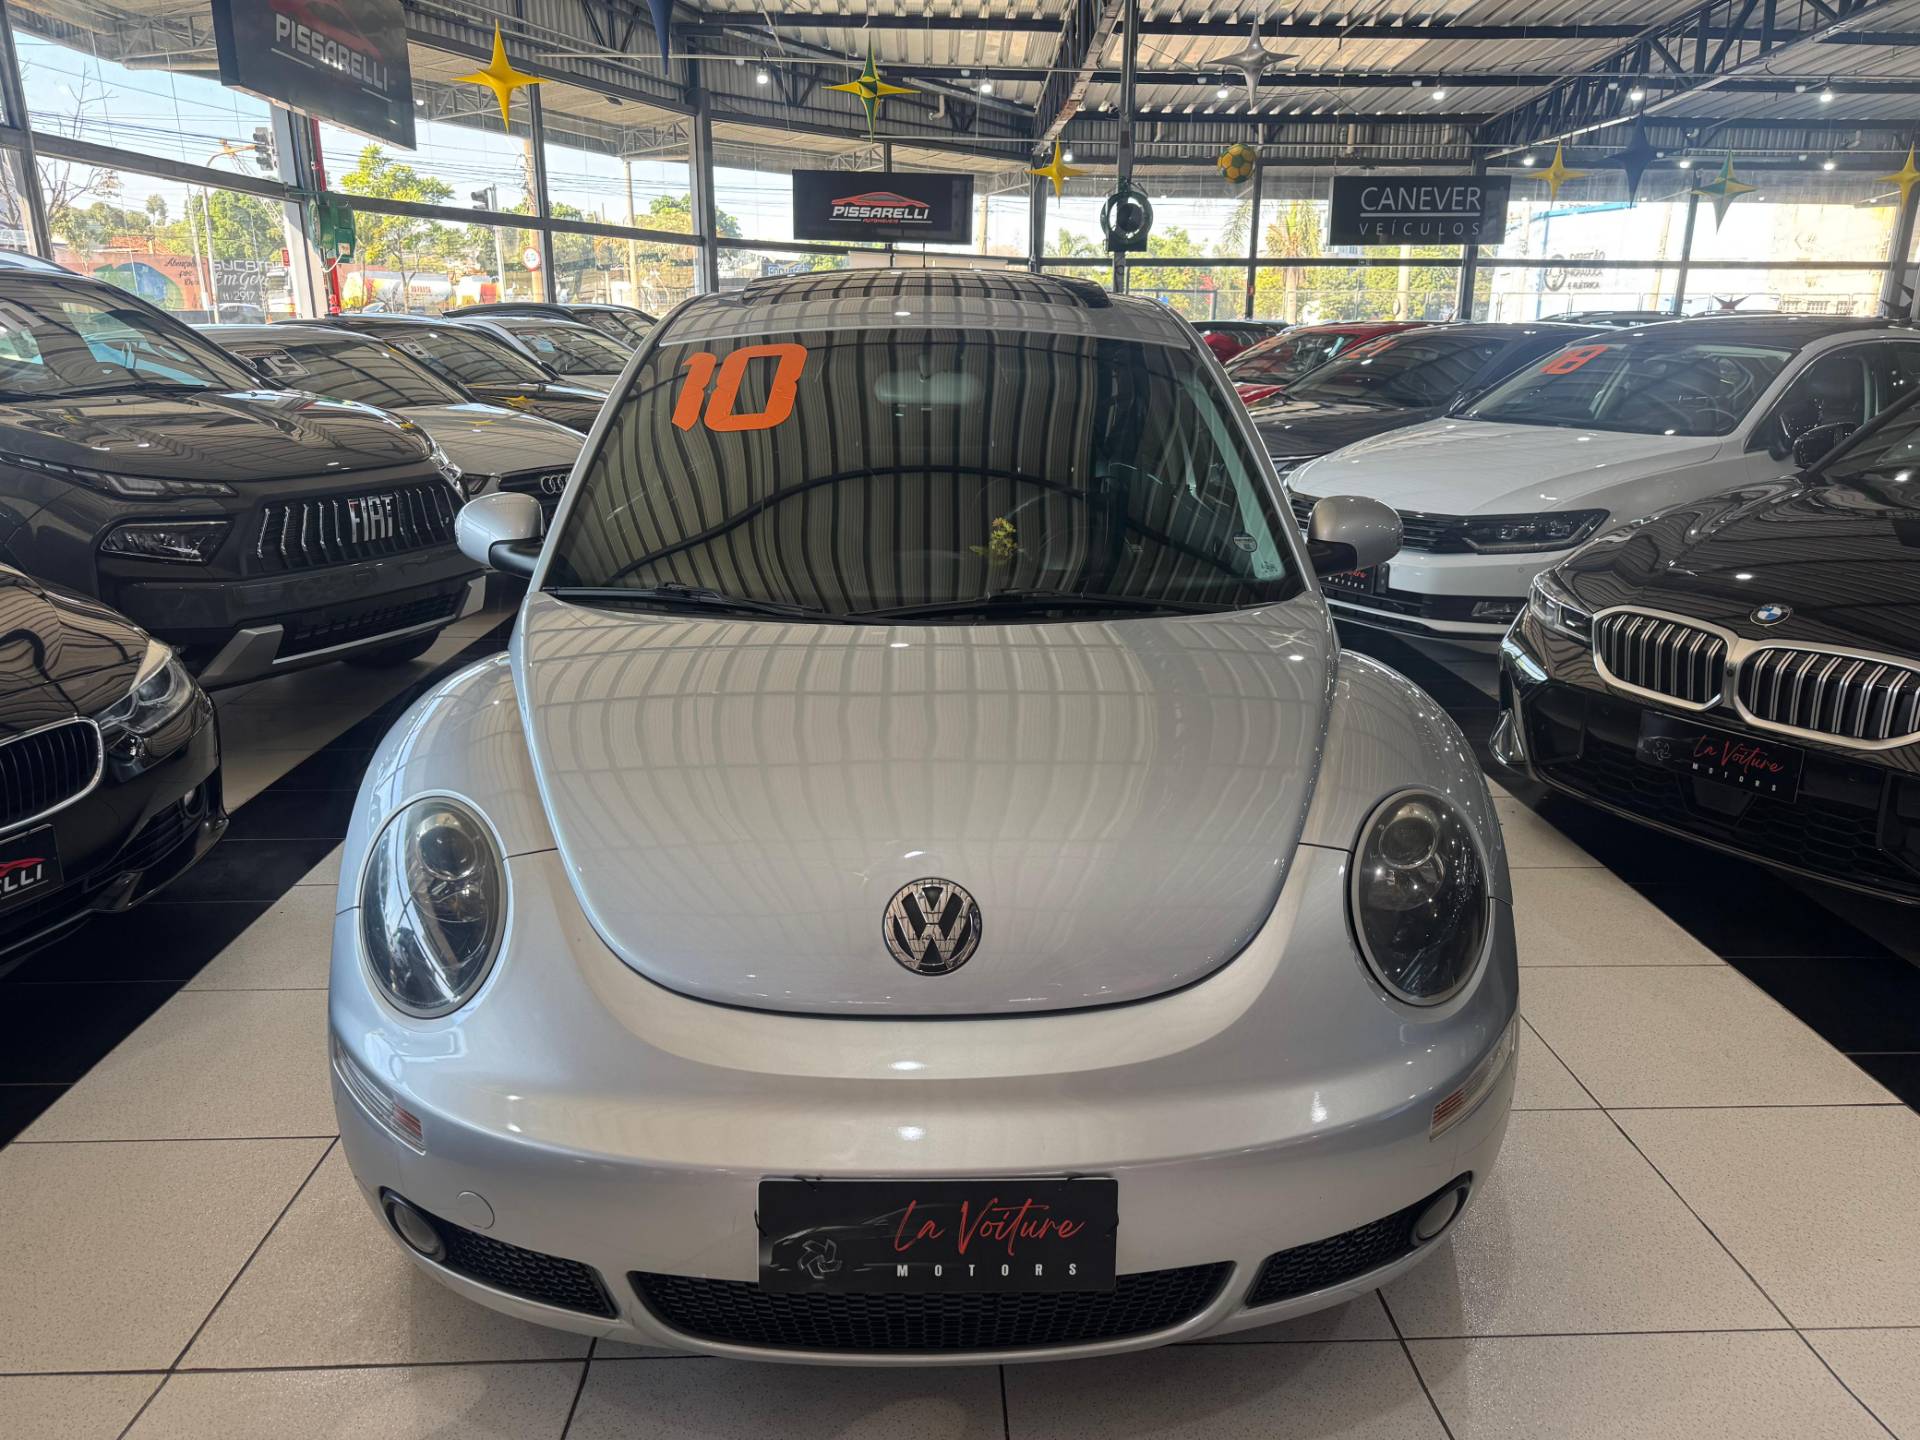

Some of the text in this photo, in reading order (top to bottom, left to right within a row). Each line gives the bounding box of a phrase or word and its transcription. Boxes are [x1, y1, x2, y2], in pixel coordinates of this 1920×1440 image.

[275, 13, 388, 92] PISSARELLI
[832, 206, 929, 219] PISSARELLI
[1360, 186, 1481, 211] CANEVER
[1358, 219, 1480, 236] VEÍCULOS
[672, 343, 808, 432] 10
[348, 494, 393, 543] FIAT
[894, 1198, 1085, 1256] La Voiture
[897, 1263, 1077, 1277] MOTORS
